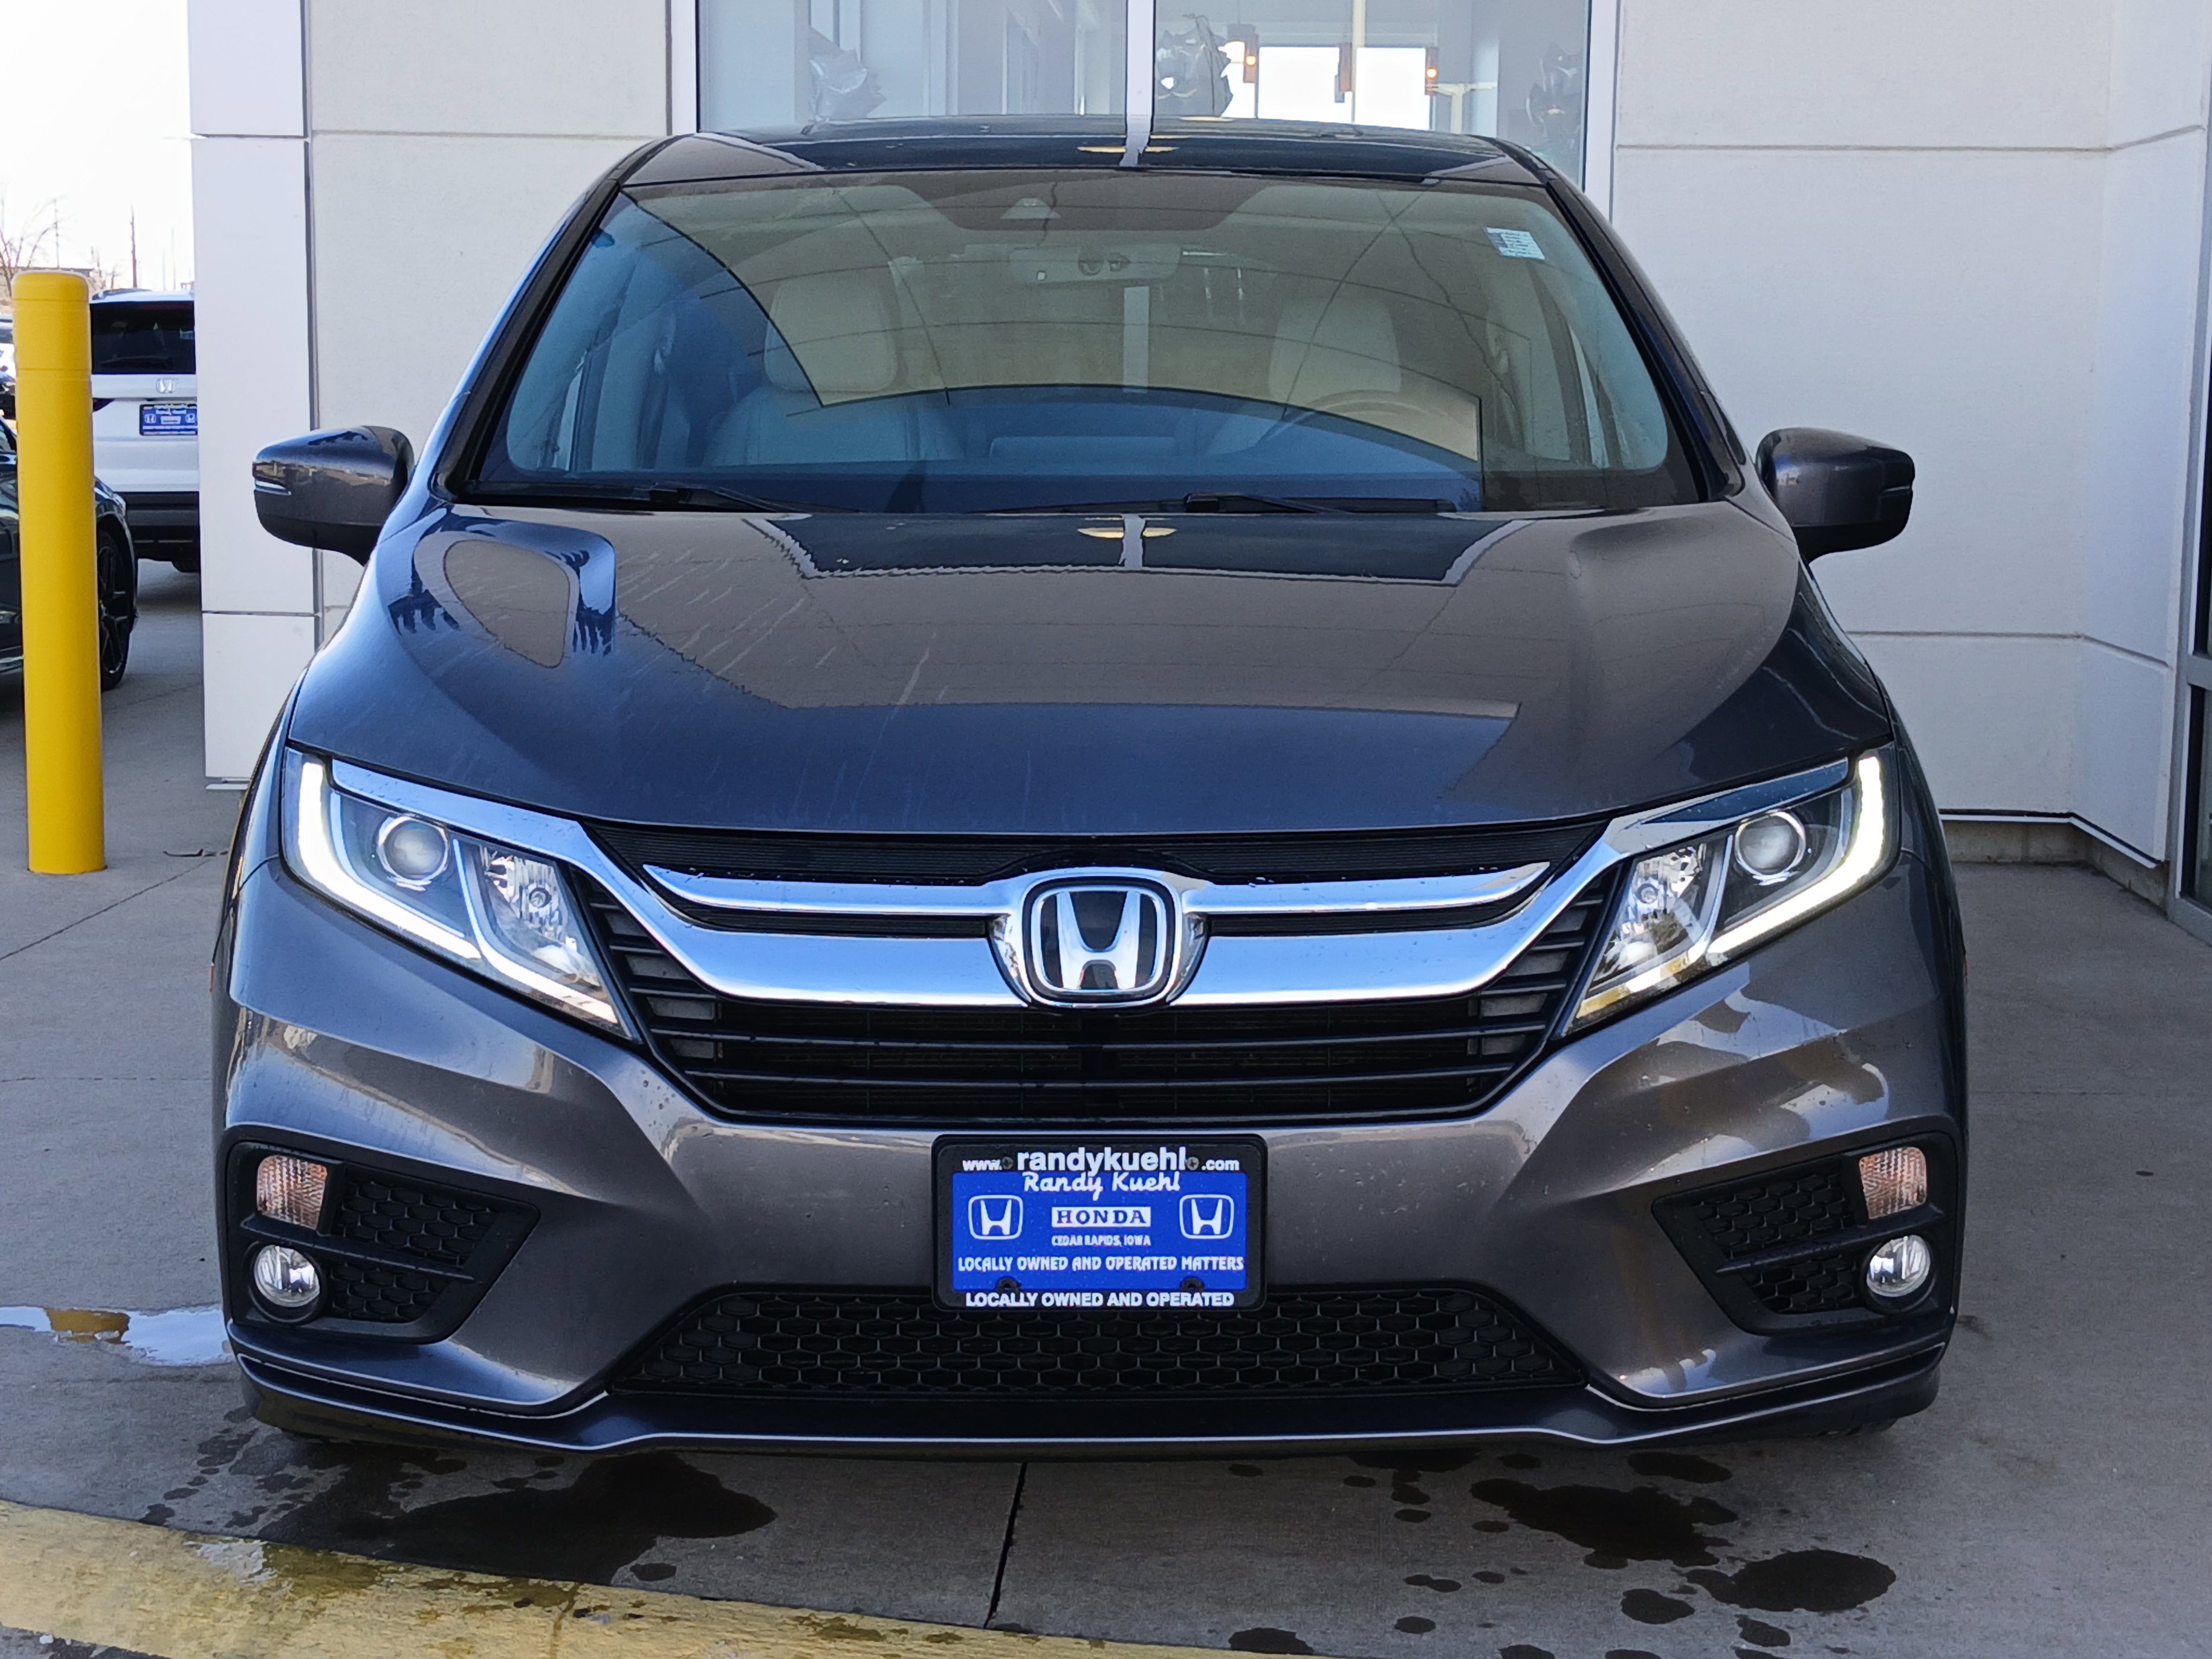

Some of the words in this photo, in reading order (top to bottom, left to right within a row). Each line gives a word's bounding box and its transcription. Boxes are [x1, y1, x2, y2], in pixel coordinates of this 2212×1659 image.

[1017, 1146, 1186, 1177] randykuehl
[1201, 1159, 1240, 1171] .com
[1022, 1171, 1103, 1201] Randy
[1112, 1171, 1180, 1191] Kuehl
[1056, 1210, 1147, 1225] HONDA
[1051, 1234, 1083, 1246] CEDAR
[1123, 1234, 1152, 1246] IOWA
[958, 1256, 1013, 1272] LOCALLY
[1017, 1256, 1069, 1271] OWNED
[1071, 1256, 1102, 1271] AND
[1105, 1256, 1178, 1271] OPERATED
[1181, 1256, 1245, 1271] MATTERS
[966, 1292, 1038, 1307] LOCALLY
[1041, 1292, 1104, 1307] OWNED
[1107, 1292, 1143, 1307] AND
[1146, 1292, 1234, 1307] OPERATED
